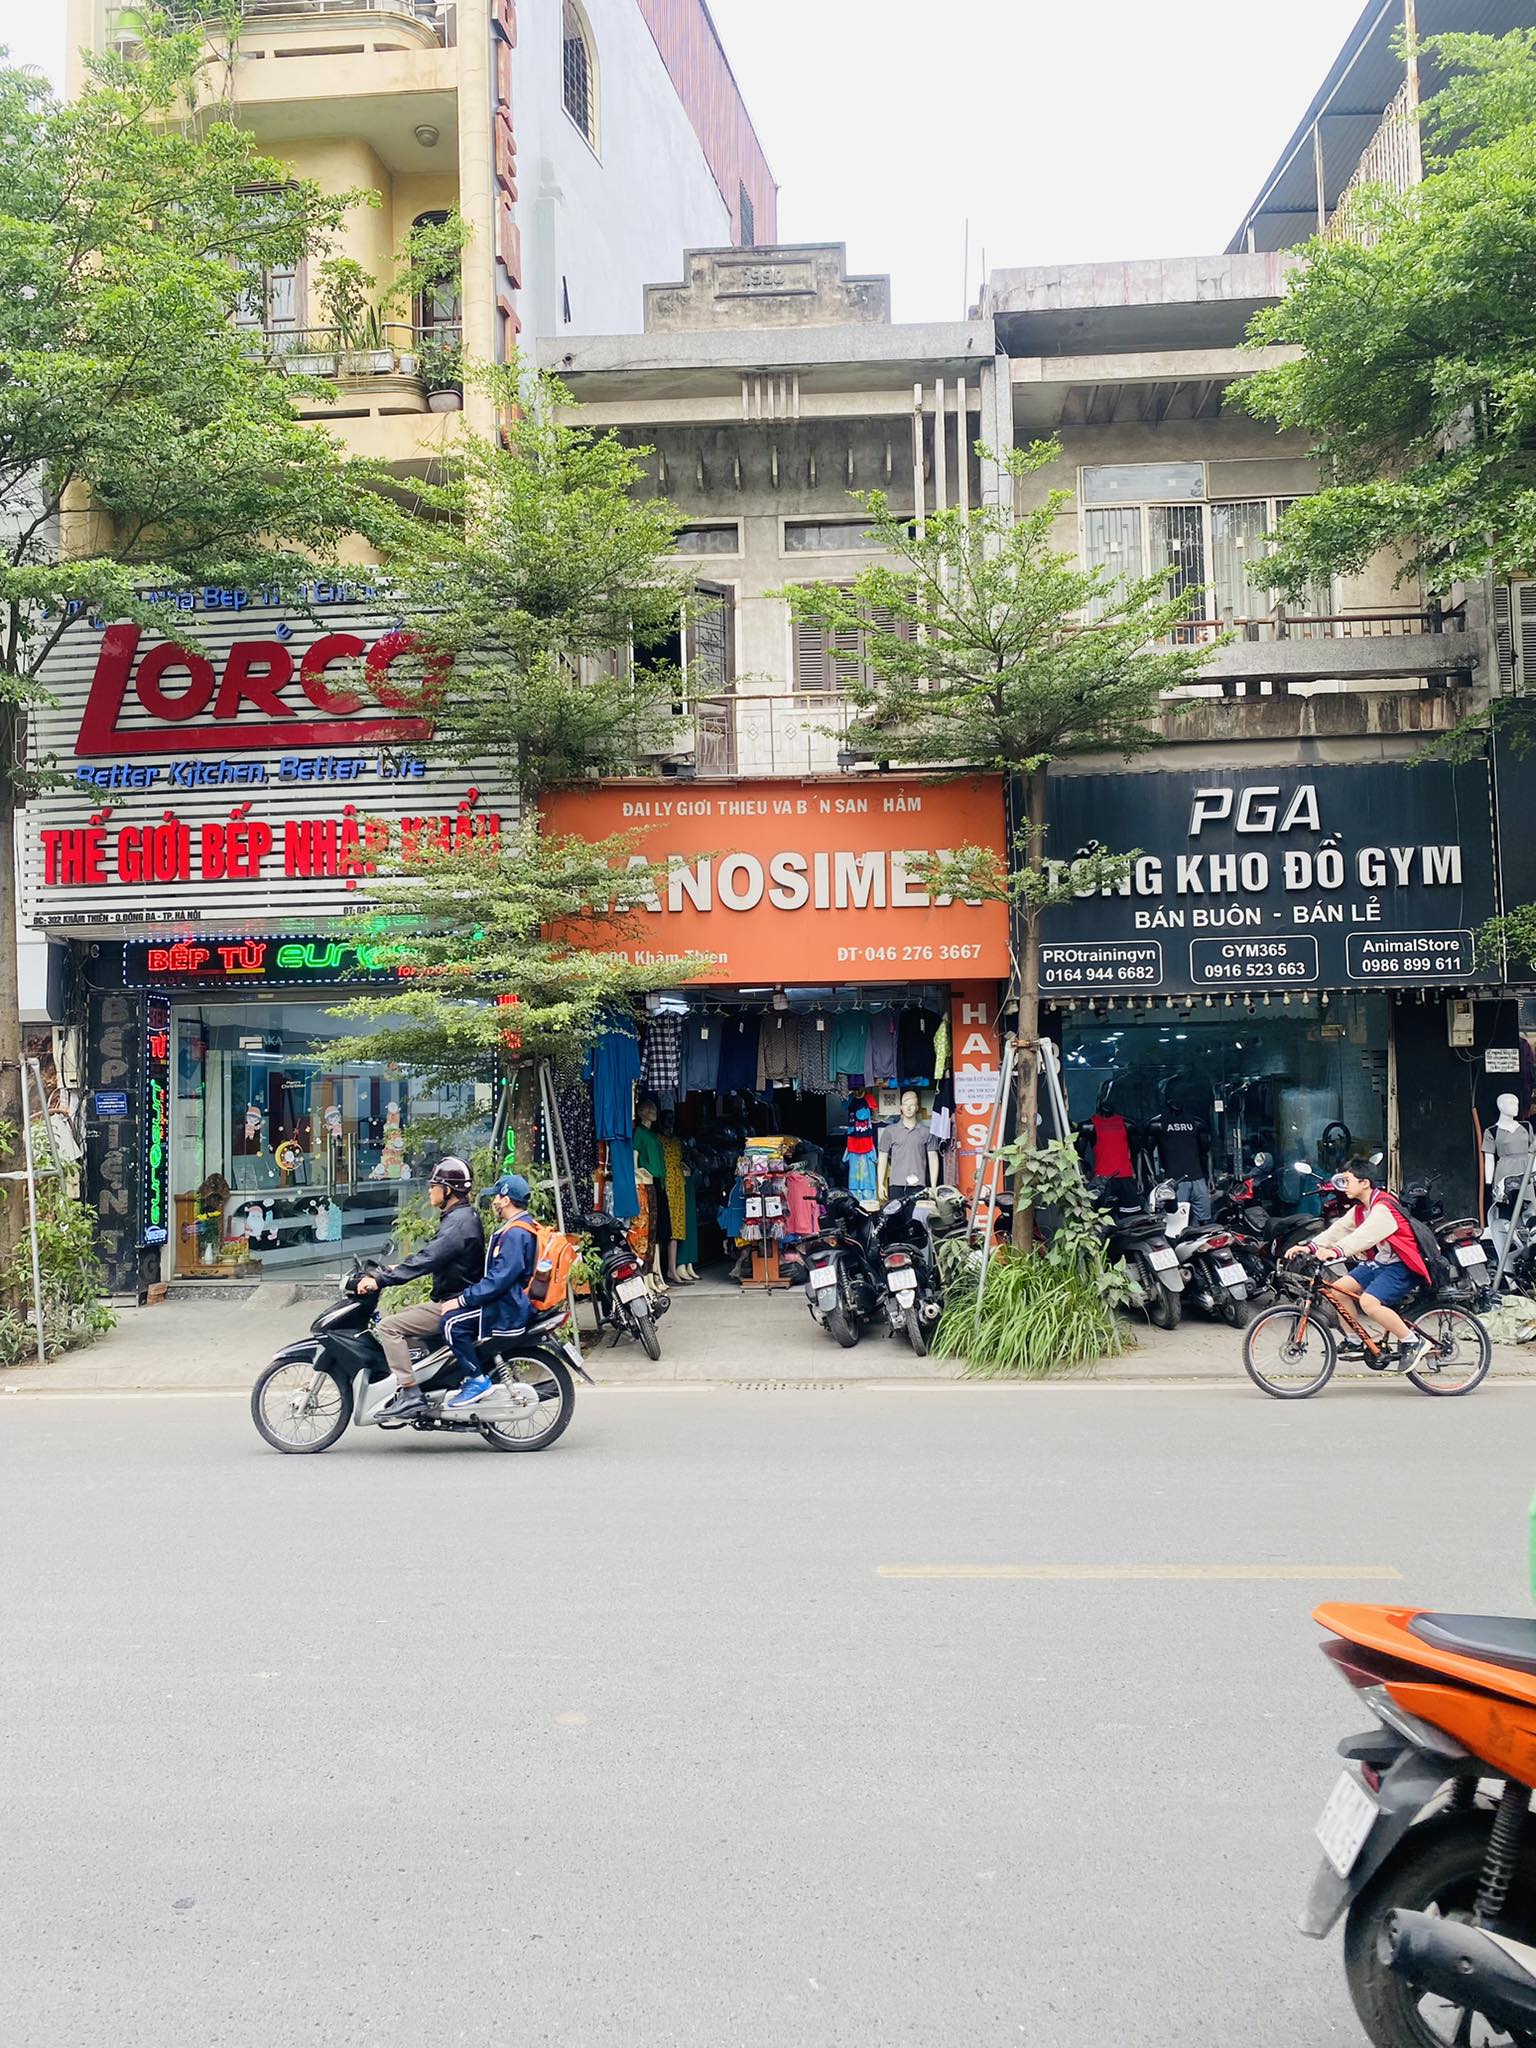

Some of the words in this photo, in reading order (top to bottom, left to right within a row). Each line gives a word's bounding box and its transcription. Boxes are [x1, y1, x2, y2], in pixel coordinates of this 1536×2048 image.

[76, 763, 160, 789] Better
[278, 755, 366, 781] Better
[1188, 784, 1322, 836] PGA
[40, 806, 113, 885] THẾ
[117, 810, 190, 883] GIỚI
[201, 801, 274, 880] BẾP
[1176, 850, 1269, 895] KHO
[1284, 832, 1345, 891] ĐỒ
[1358, 845, 1462, 889] GYM
[1135, 906, 1185, 930] BÁN
[1192, 901, 1262, 927] BUÔN
[1293, 900, 1345, 924] BÁN
[1351, 894, 1381, 922] LẺ
[902, 945, 933, 961] 276
[939, 944, 982, 960] 3667
[1222, 943, 1287, 959] GYM365
[1362, 937, 1460, 953] AnimalStore
[148, 940, 210, 971] BẾP
[218, 940, 266, 969] TỪ
[1043, 948, 1156, 963] PROtrainingvn
[1204, 963, 1239, 978] 0916
[1243, 962, 1272, 977] 523
[1275, 961, 1306, 976] 663
[1362, 957, 1396, 973] 0986
[1400, 957, 1431, 972] 899
[1435, 956, 1461, 971] 611
[1046, 968, 1082, 982] 0164
[1086, 967, 1113, 981] 944
[1118, 966, 1154, 980] 6682
